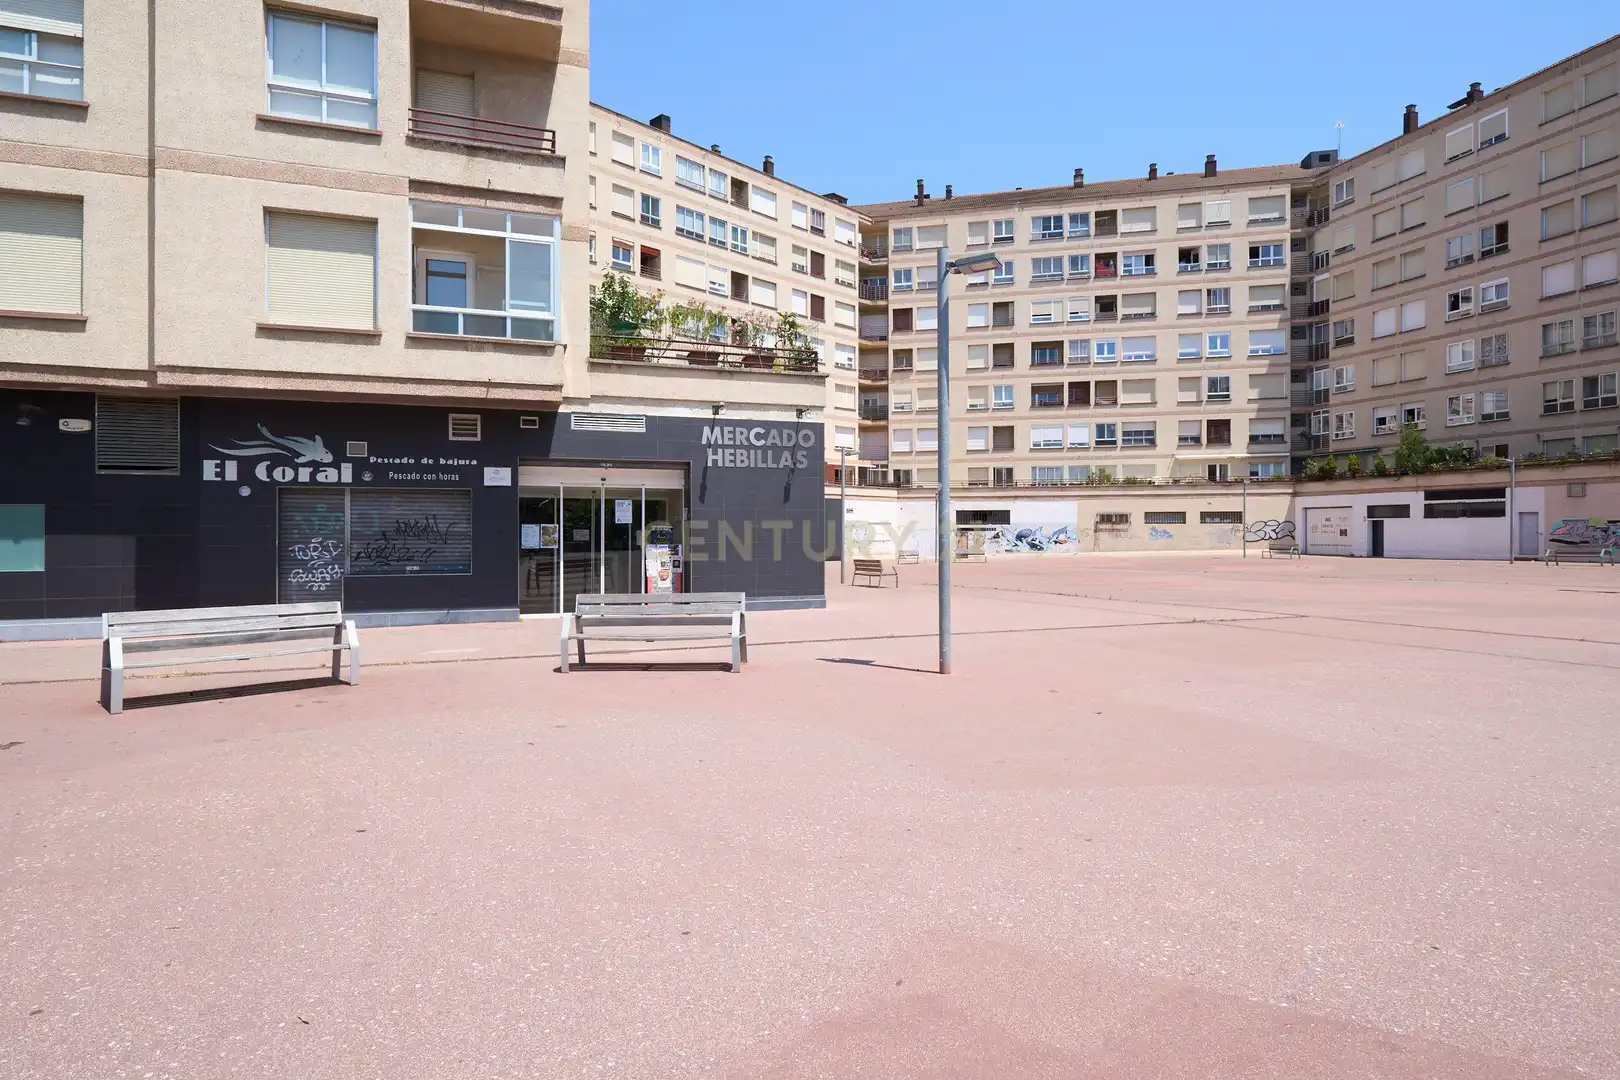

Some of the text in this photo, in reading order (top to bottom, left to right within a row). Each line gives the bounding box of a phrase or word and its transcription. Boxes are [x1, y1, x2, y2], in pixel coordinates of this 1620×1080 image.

[701, 425, 816, 448] MERCADO
[369, 456, 478, 466] Pescado de bajura
[707, 447, 809, 469] HEBILLAS
[202, 459, 238, 482] El
[254, 460, 353, 483] Coral
[388, 471, 460, 481] Pescado con horas
